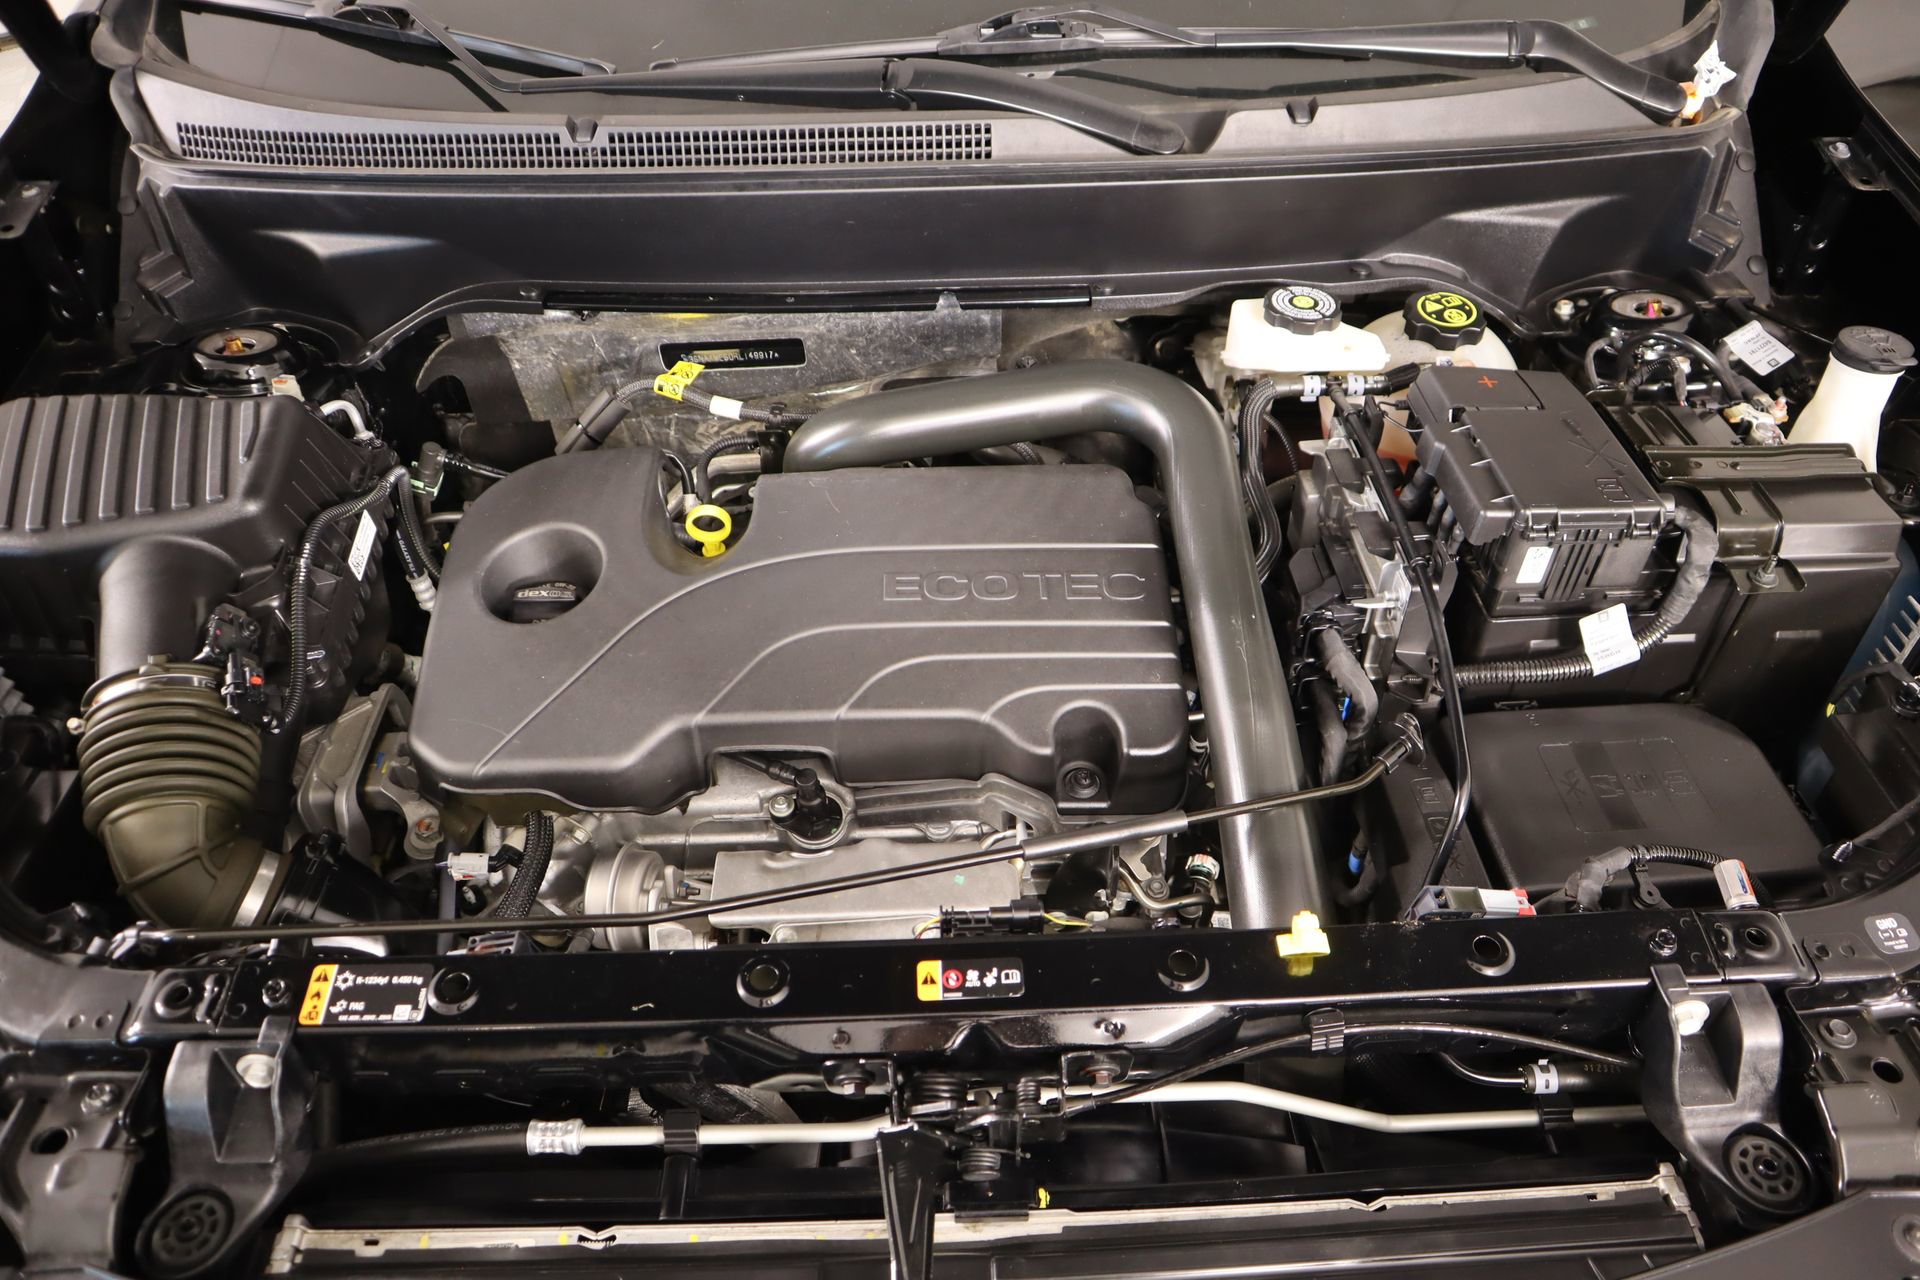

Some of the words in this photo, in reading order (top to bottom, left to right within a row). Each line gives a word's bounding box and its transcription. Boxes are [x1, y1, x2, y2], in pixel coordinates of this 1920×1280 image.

[883, 571, 1146, 601] ECOTEC
[1875, 917, 1898, 930] GND
[349, 1002, 365, 1011] PAG
